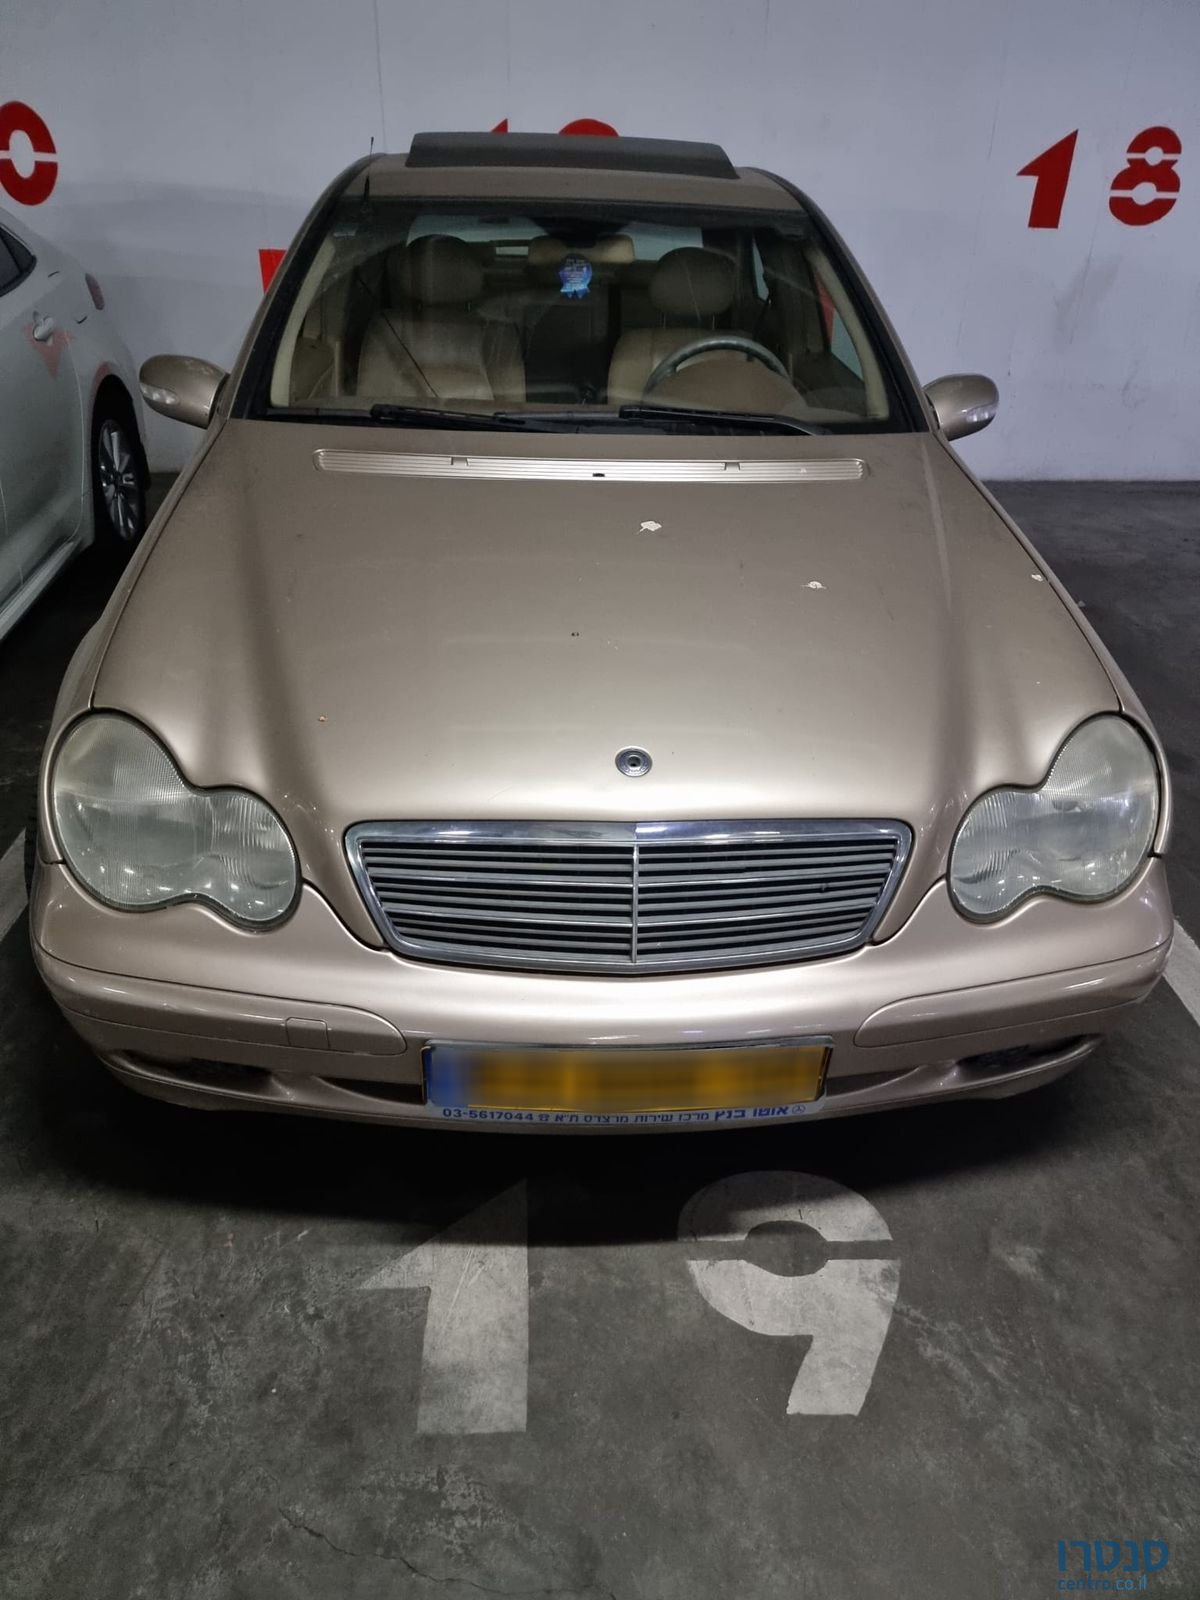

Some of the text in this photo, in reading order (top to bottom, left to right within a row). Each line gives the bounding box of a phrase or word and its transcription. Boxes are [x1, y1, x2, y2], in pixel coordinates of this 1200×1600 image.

[1016, 126, 1182, 230] 18
[442, 1107, 534, 1121] 03-5617044
[714, 1108, 746, 1121] בנץ
[753, 1105, 789, 1117] אוטו
[356, 1169, 901, 1435] 19
